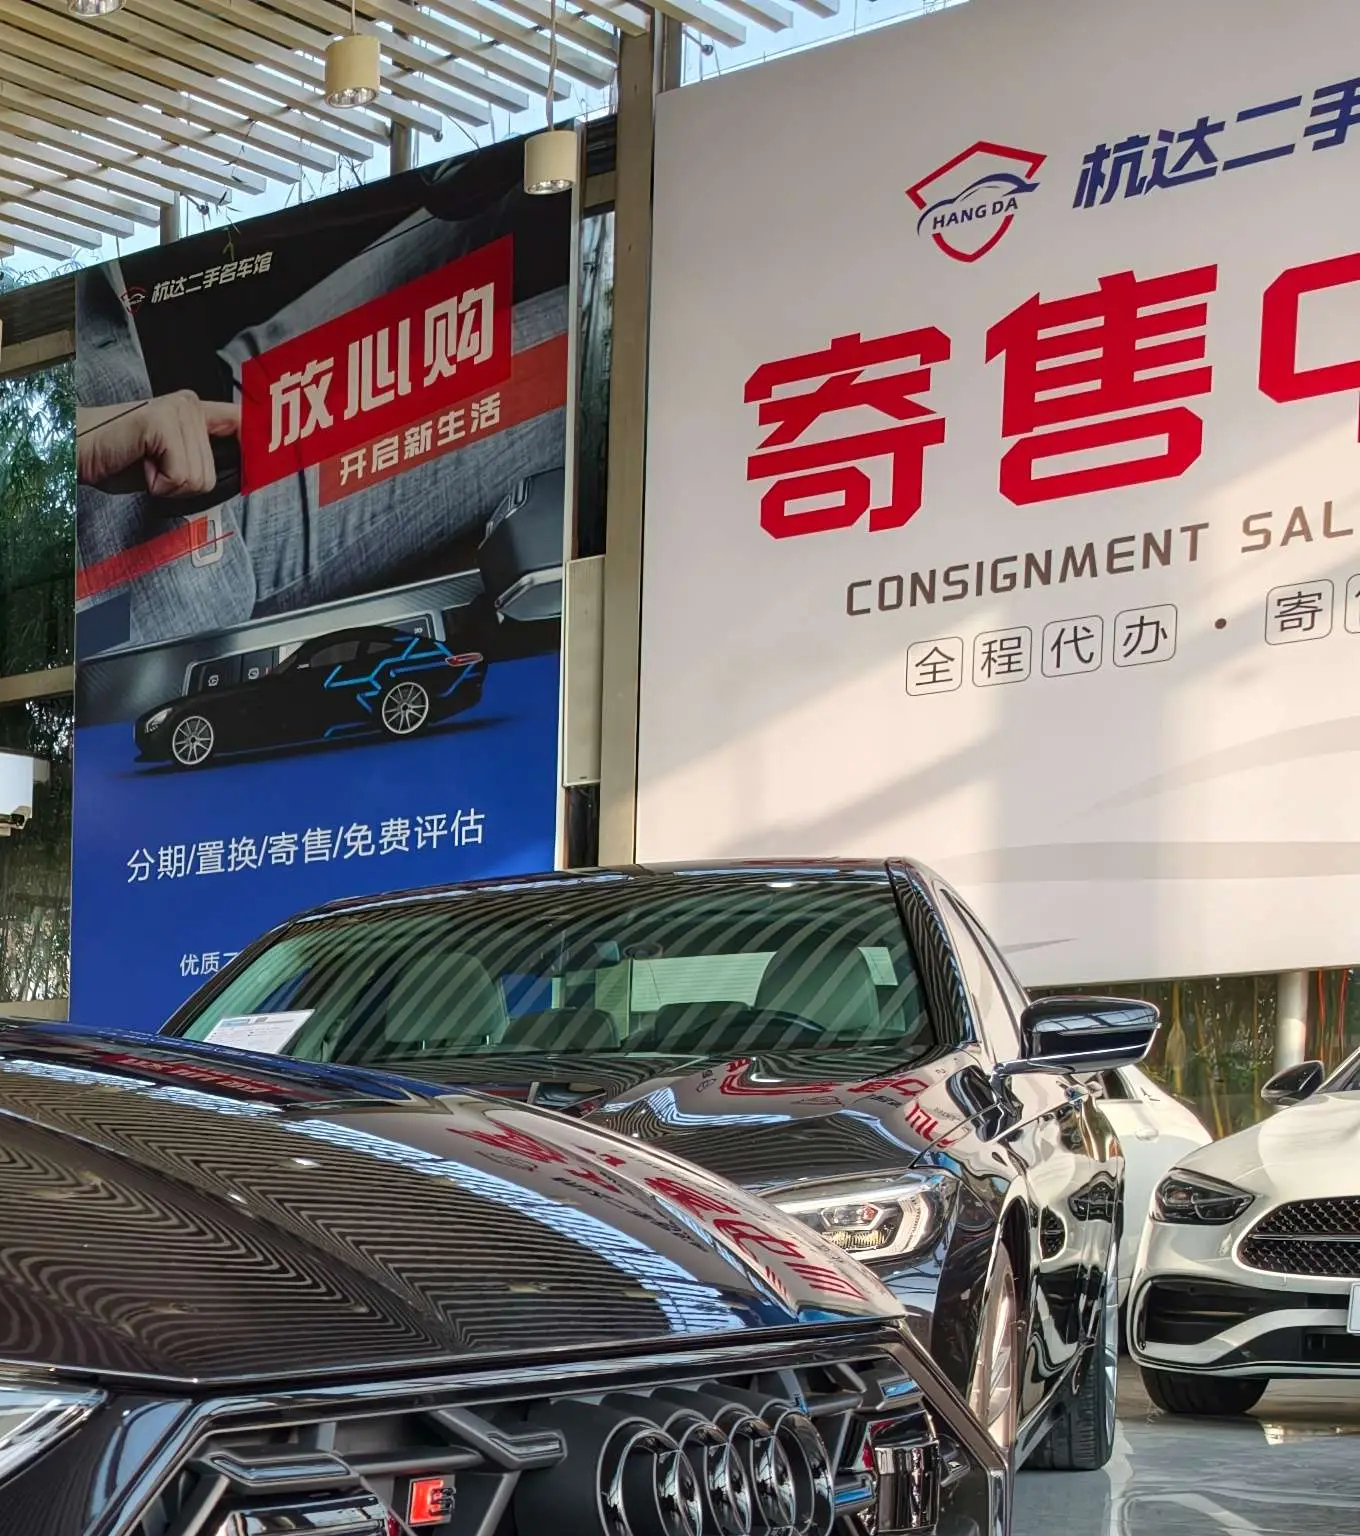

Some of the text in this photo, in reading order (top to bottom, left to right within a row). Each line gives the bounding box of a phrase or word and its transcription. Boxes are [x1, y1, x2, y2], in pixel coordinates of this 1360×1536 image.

[1072, 77, 1360, 209] 杭达二手
[932, 197, 1019, 231] HANG DA
[151, 252, 273, 304] 杭达二手名车馆
[268, 281, 496, 453] 放心购
[339, 392, 501, 486] 开启新生活
[846, 501, 1354, 617] CONSIGNMENT SAL
[914, 615, 1168, 688] 全程代办
[126, 808, 486, 884] 分期/置换/寄售/免费评估
